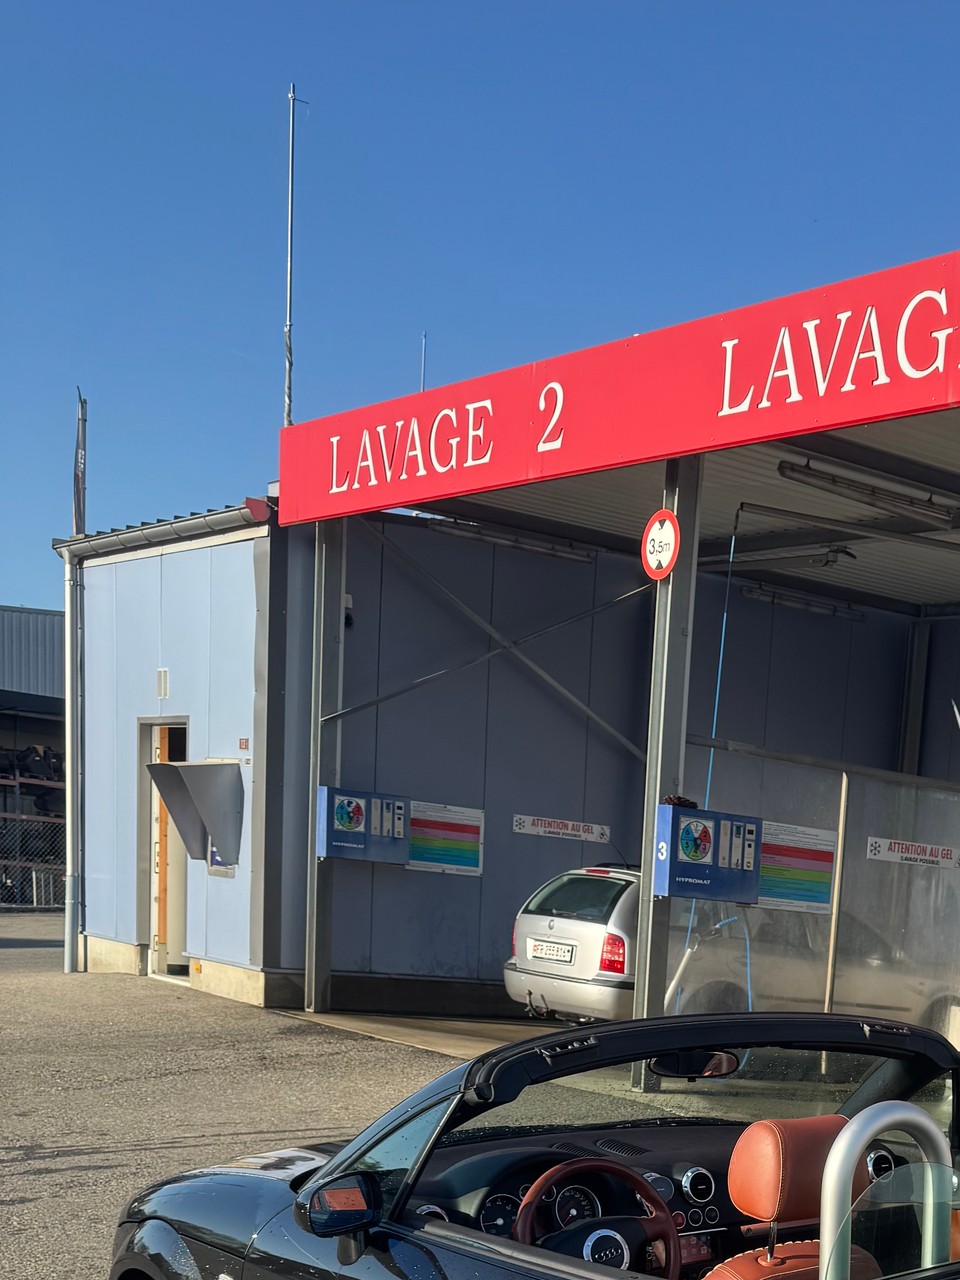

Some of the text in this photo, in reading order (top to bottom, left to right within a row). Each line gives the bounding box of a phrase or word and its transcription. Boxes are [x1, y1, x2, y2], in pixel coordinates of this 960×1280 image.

[328, 382, 564, 494] LAVAGE 2
[648, 538, 670, 556] 3,5m
[531, 818, 594, 834] ATTENTION AU GEL
[657, 841, 667, 860] 3
[887, 841, 953, 860] ATTENTION AU GEL
